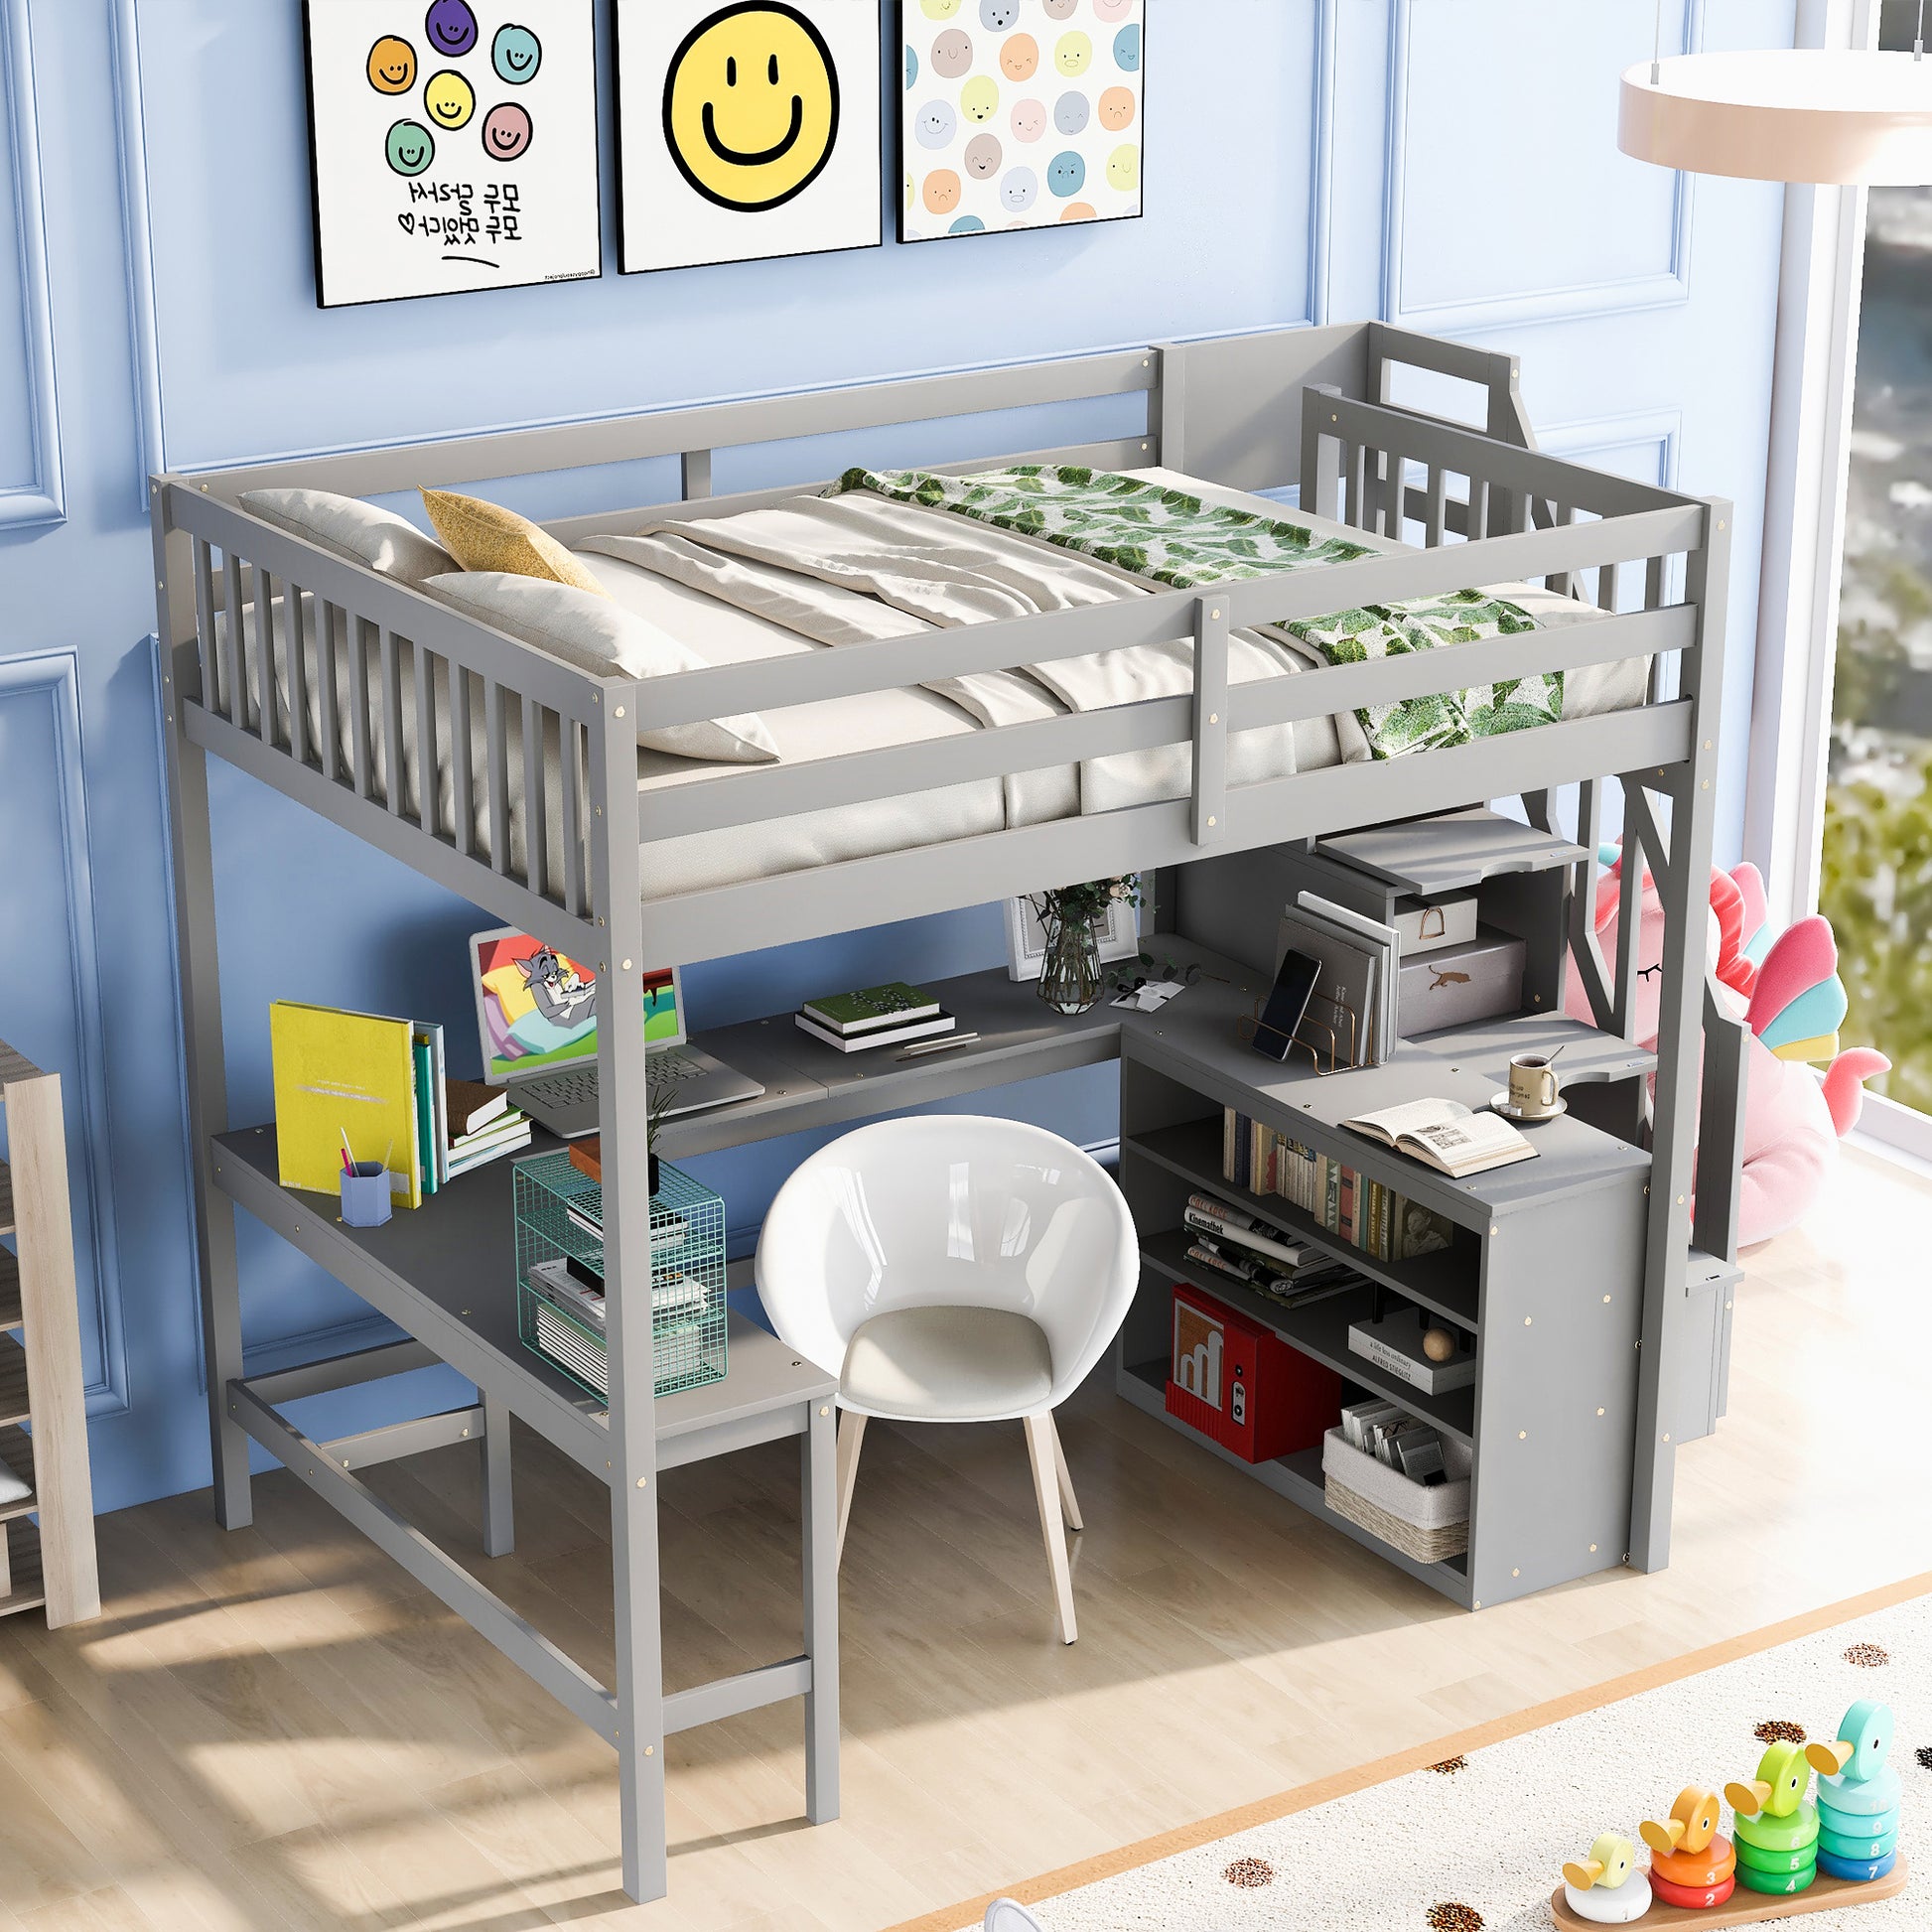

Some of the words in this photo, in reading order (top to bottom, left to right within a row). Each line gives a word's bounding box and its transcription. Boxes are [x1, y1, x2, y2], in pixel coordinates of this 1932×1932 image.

[1188, 1212, 1224, 1235] Kinemathek
[1372, 1354, 1389, 1369] ALFRED
[1872, 1821, 1882, 1834] 9
[1791, 1837, 1800, 1849] 6
[1870, 1843, 1880, 1857] 8
[1790, 1857, 1800, 1870] 5
[1707, 1871, 1716, 1884] 3
[1868, 1865, 1878, 1879] 7
[1785, 1878, 1796, 1892] 4
[1705, 1893, 1716, 1906] 2
